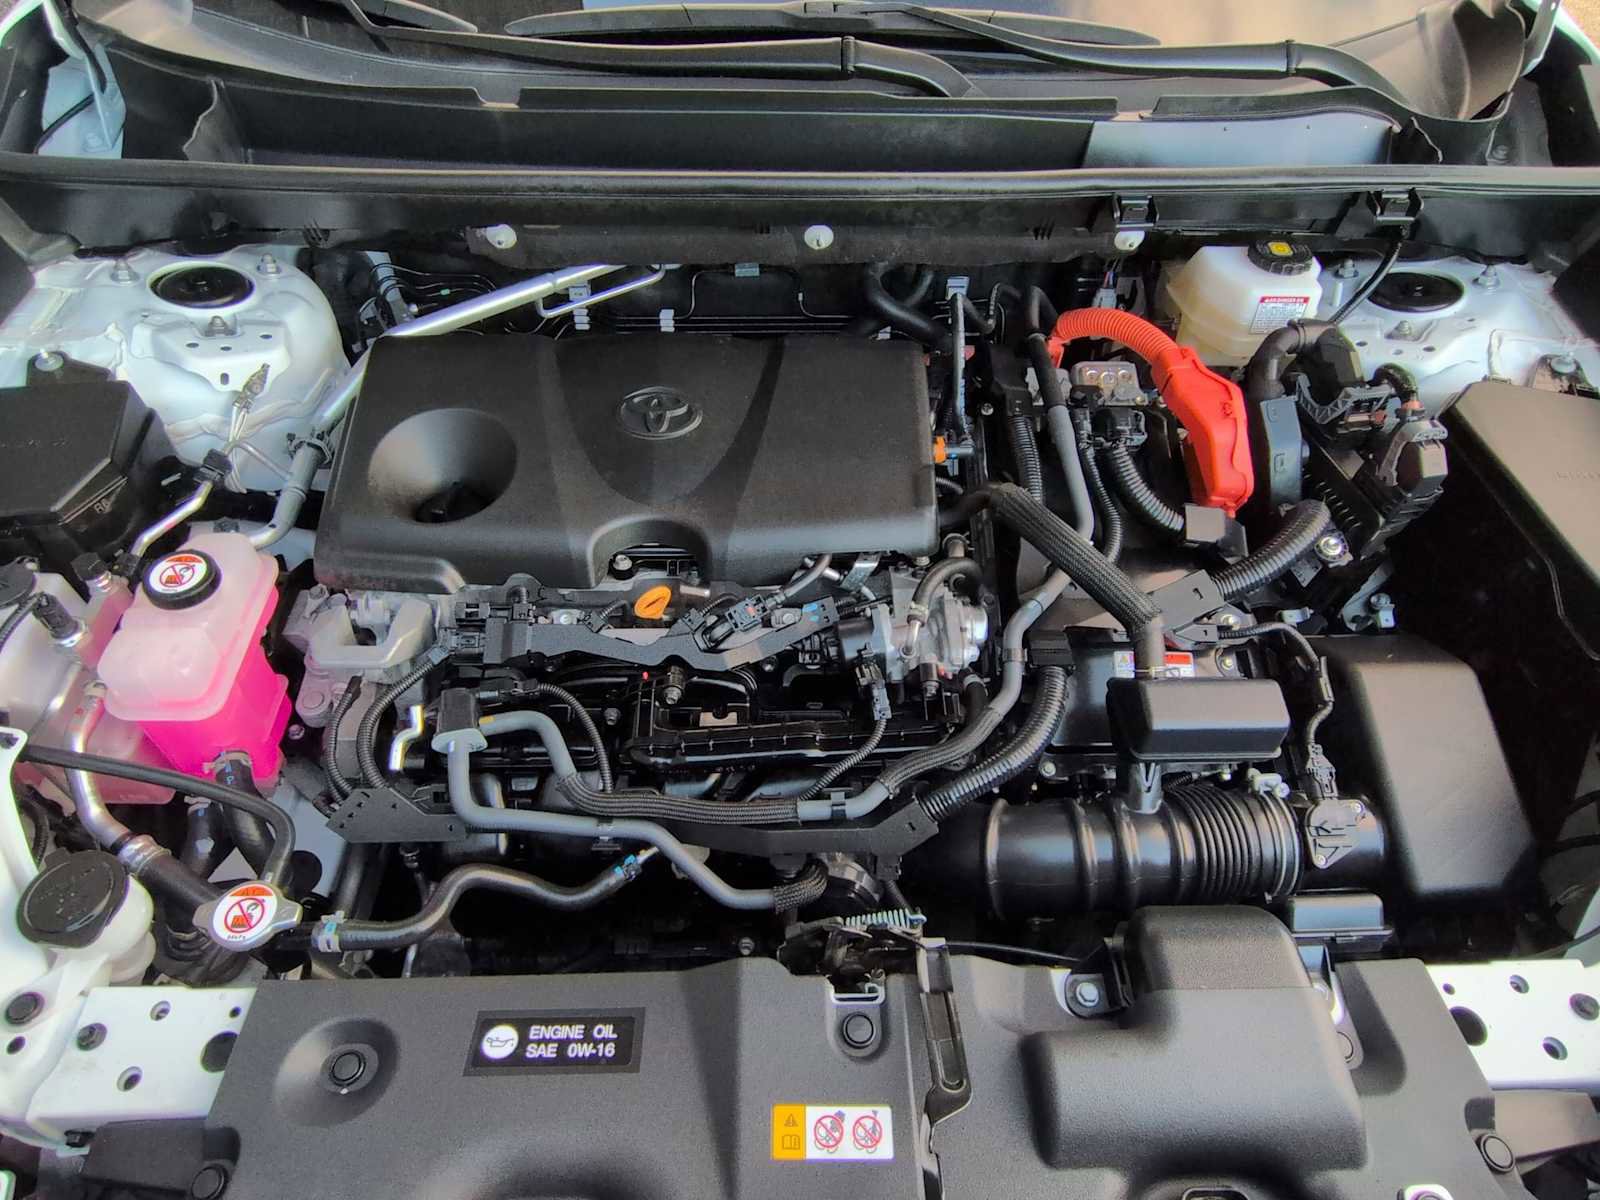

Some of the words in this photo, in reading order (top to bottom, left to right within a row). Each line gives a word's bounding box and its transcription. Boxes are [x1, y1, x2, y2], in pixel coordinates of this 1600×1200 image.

[529, 1024, 585, 1039] ENGINE
[593, 1024, 618, 1039] OIL
[525, 1042, 558, 1058] SAE
[567, 1042, 616, 1058] 0W-16
